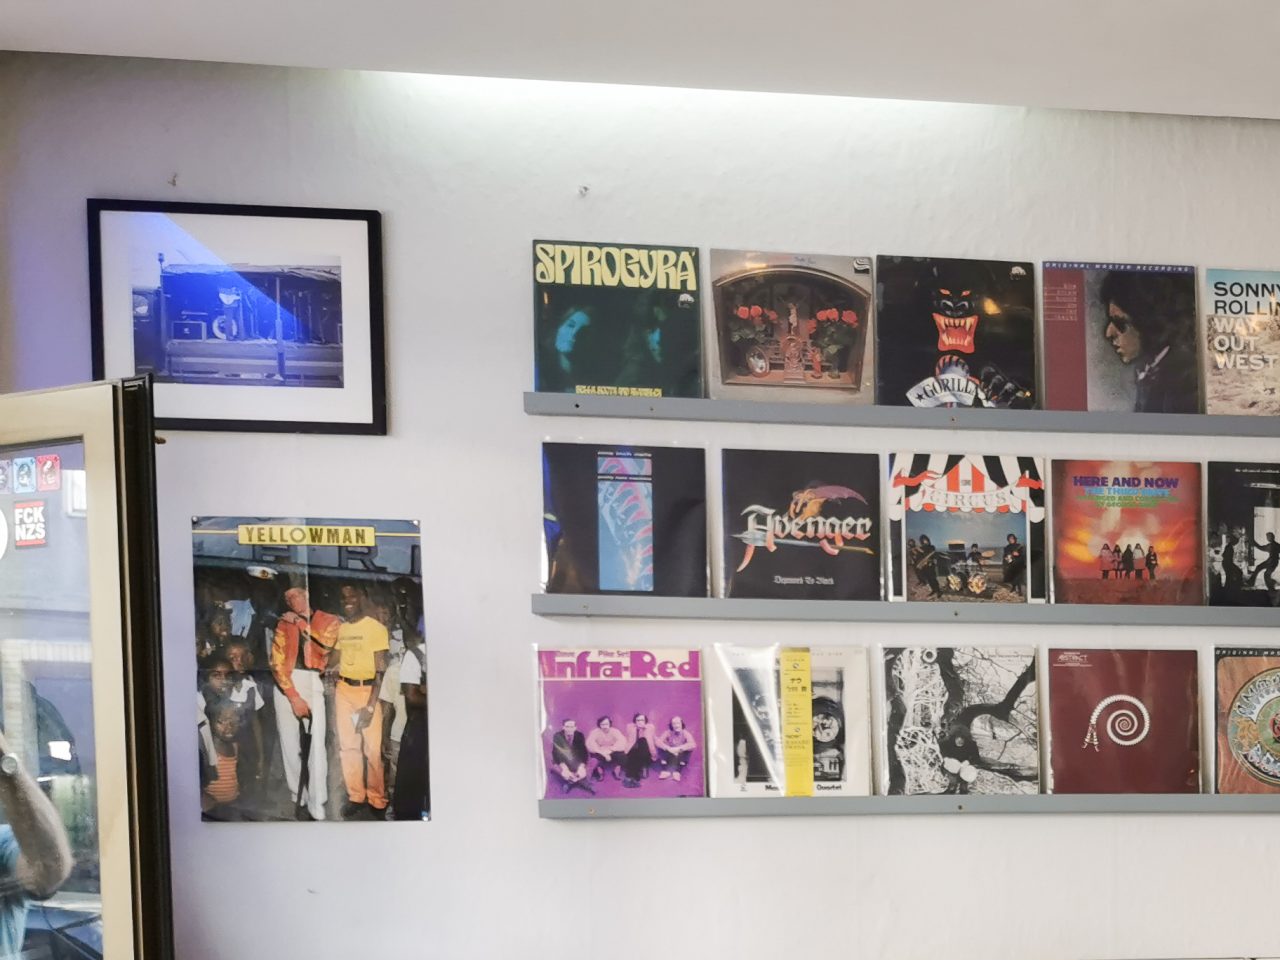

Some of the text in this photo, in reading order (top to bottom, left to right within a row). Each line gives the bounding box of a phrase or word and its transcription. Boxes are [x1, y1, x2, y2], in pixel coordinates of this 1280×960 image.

[1214, 317, 1257, 335] WAY
[1214, 335, 1260, 352] OUT
[1215, 353, 1279, 370] WEST
[1073, 476, 1180, 489] HERE AND NOW
[930, 492, 1007, 507] CIRCUS
[14, 507, 45, 524] FCK
[15, 523, 46, 541] NZS
[245, 527, 367, 545] YELLOWMAN
